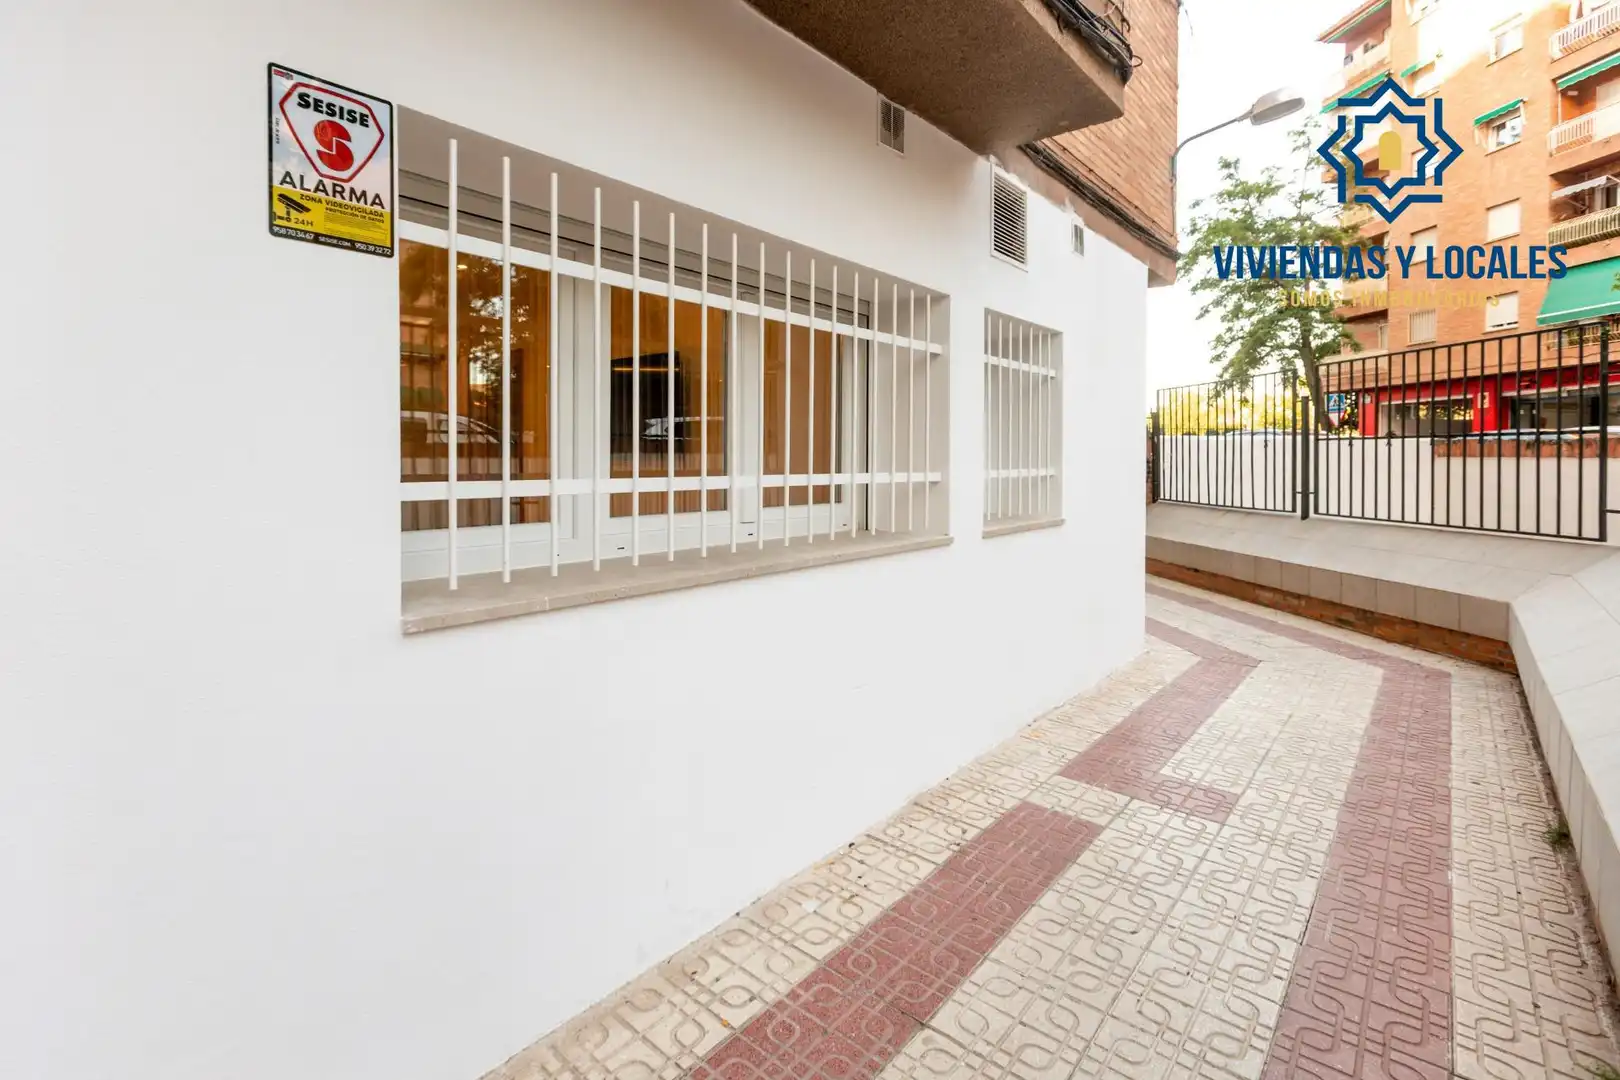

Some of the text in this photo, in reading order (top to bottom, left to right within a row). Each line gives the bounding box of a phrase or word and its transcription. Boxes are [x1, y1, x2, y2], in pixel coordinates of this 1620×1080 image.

[297, 92, 370, 128] SESISE
[279, 170, 386, 210] ALARMA
[299, 193, 385, 219] ZONA VIDEOVIGILADA
[294, 217, 313, 227] 24H
